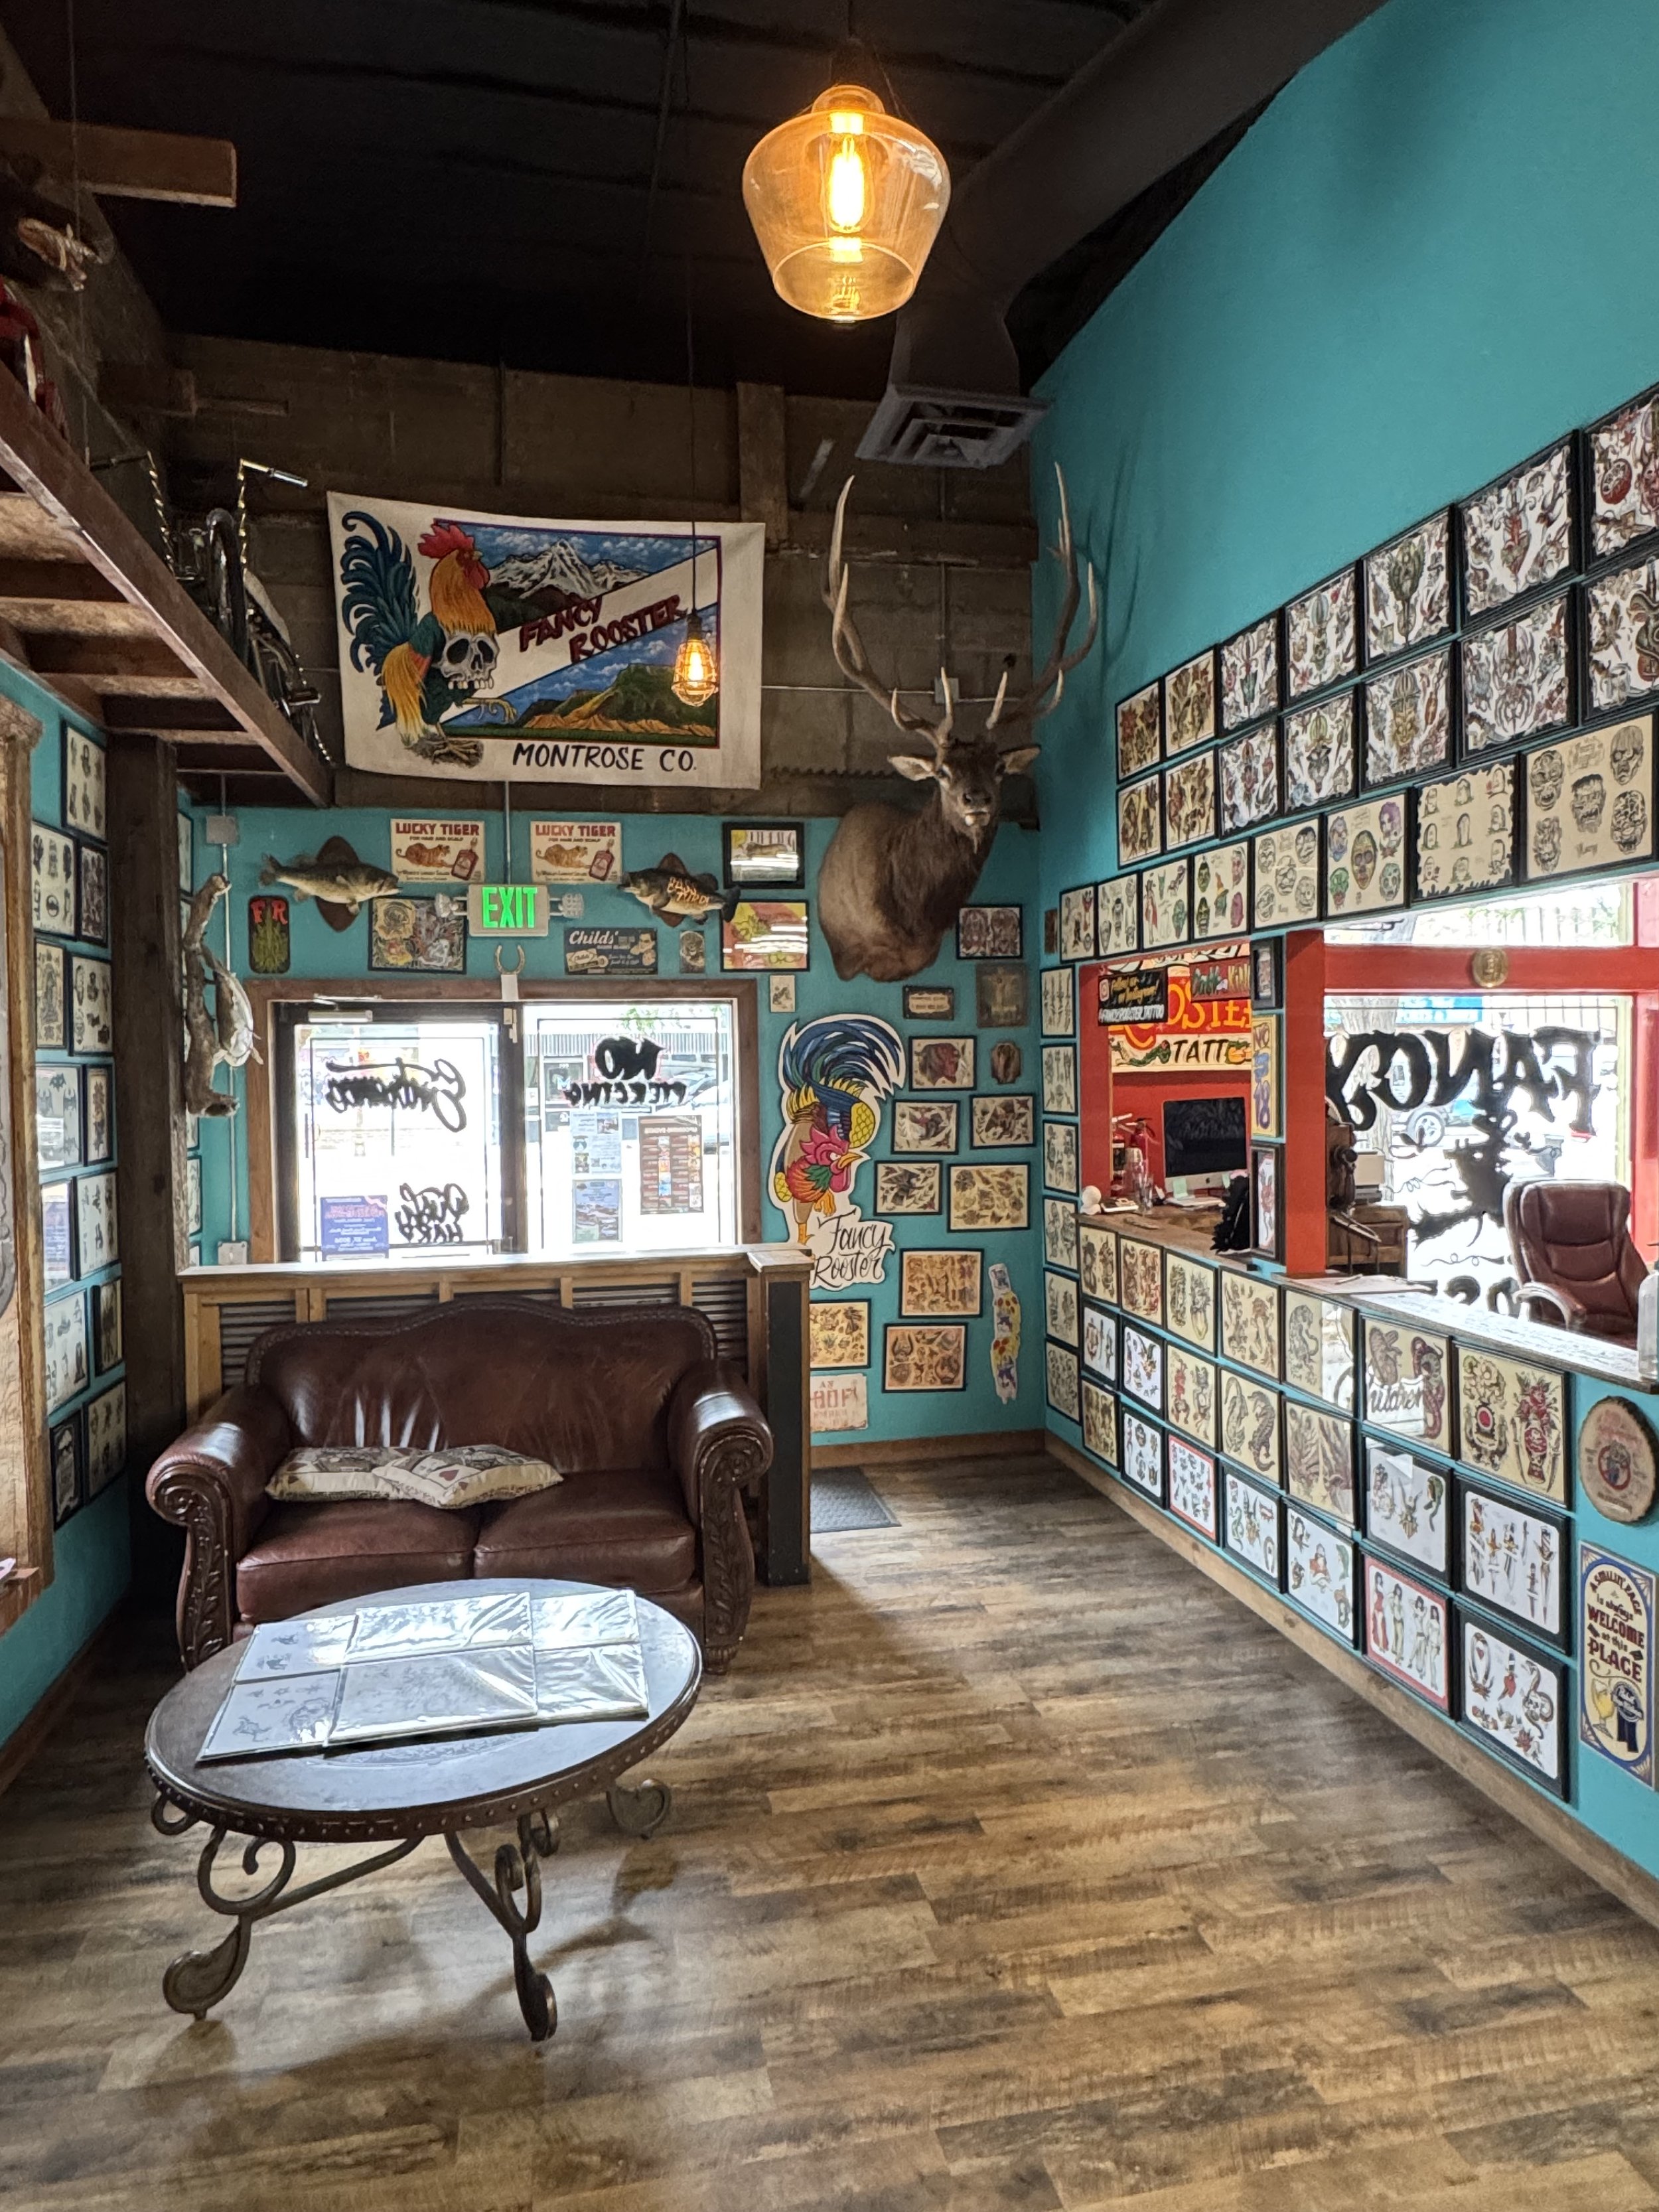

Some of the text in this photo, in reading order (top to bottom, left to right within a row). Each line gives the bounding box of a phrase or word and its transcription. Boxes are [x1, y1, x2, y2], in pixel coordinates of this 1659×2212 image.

[519, 595, 603, 652] FANCY
[569, 594, 688, 664] ROOSTER
[513, 743, 697, 771] MONTROSE CO.
[396, 822, 480, 836] LUCKY TIGER
[536, 824, 616, 837] LUCKY TIGER
[482, 886, 537, 928] EXIT
[569, 930, 619, 944] Childs'
[817, 1207, 893, 1259] Fancy
[812, 1250, 883, 1288] Rooster
[1590, 1581, 1598, 1593] A
[1624, 1583, 1642, 1616] FACE
[1587, 1603, 1644, 1649] WELCOME
[1587, 1637, 1642, 1682] PLACE
